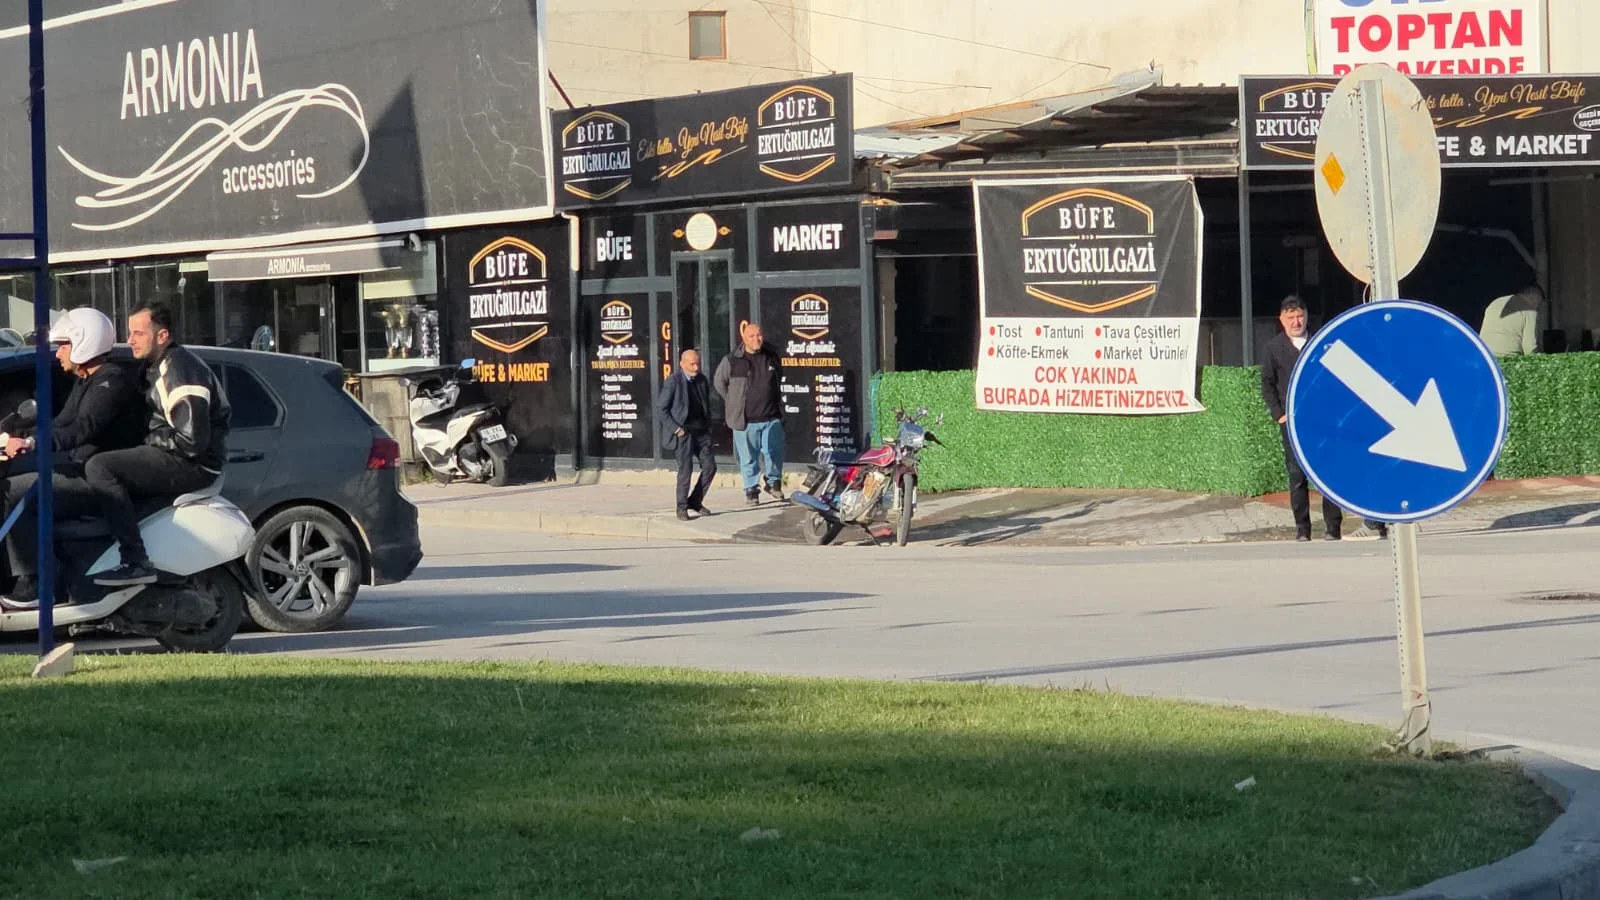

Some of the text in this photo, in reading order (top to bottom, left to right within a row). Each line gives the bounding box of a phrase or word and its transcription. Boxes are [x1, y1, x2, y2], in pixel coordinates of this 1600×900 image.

[1331, 9, 1523, 53] TOPTAN
[120, 28, 264, 119] ARMONIA
[1333, 56, 1524, 75] PAKENDE
[1284, 89, 1333, 109] BÜF
[1510, 83, 1549, 104] Nesil
[1550, 80, 1586, 104] Büfe
[774, 96, 817, 120] BÜFE
[577, 121, 614, 144] BÜFE
[757, 125, 836, 156] ERTUĞRULGAZİ
[1469, 135, 1486, 156] &
[1495, 134, 1592, 156] MARKET
[222, 149, 316, 194] accessories
[562, 147, 632, 176] ERTUĞRULGAZİ
[1059, 203, 1116, 230] BÜFE
[596, 229, 633, 262] BÜFE
[772, 222, 844, 253] MARKET
[267, 256, 305, 275] ARMONIA
[485, 252, 529, 279] BÜFE
[1023, 241, 1157, 274] ERTUĞRULGAZİ
[469, 284, 548, 319] ERTUĞRULGAZİ
[996, 324, 1023, 338] Tost
[1043, 324, 1084, 339] Tantuni
[1102, 324, 1130, 339] Tava
[996, 344, 1069, 359] Köfte-Ekmek
[1103, 346, 1143, 360] Market
[497, 363, 506, 382] &
[508, 362, 550, 382] MARKET
[1071, 366, 1138, 385] YAKINDA
[983, 387, 1050, 407] BURADA
